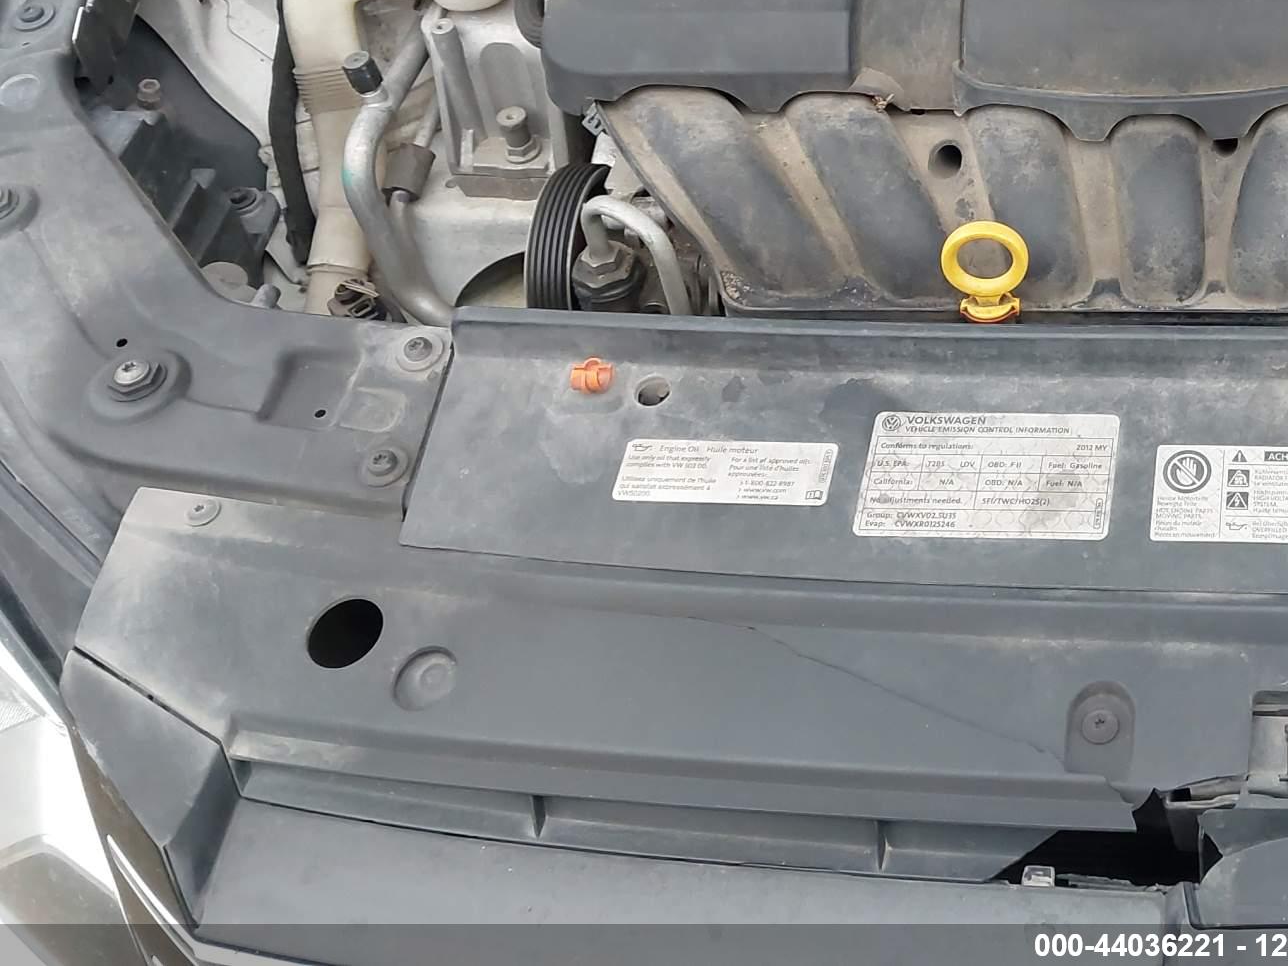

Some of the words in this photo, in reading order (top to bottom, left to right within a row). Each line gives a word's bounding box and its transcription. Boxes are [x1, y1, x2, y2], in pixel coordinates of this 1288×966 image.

[906, 416, 986, 425] VOLKSWAGEN
[659, 444, 688, 454] Engine
[706, 445, 728, 454] Huile
[880, 442, 917, 450] Conforms
[928, 443, 974, 451] regulations:
[1069, 462, 1103, 471] Gasoline
[873, 477, 913, 485] California:
